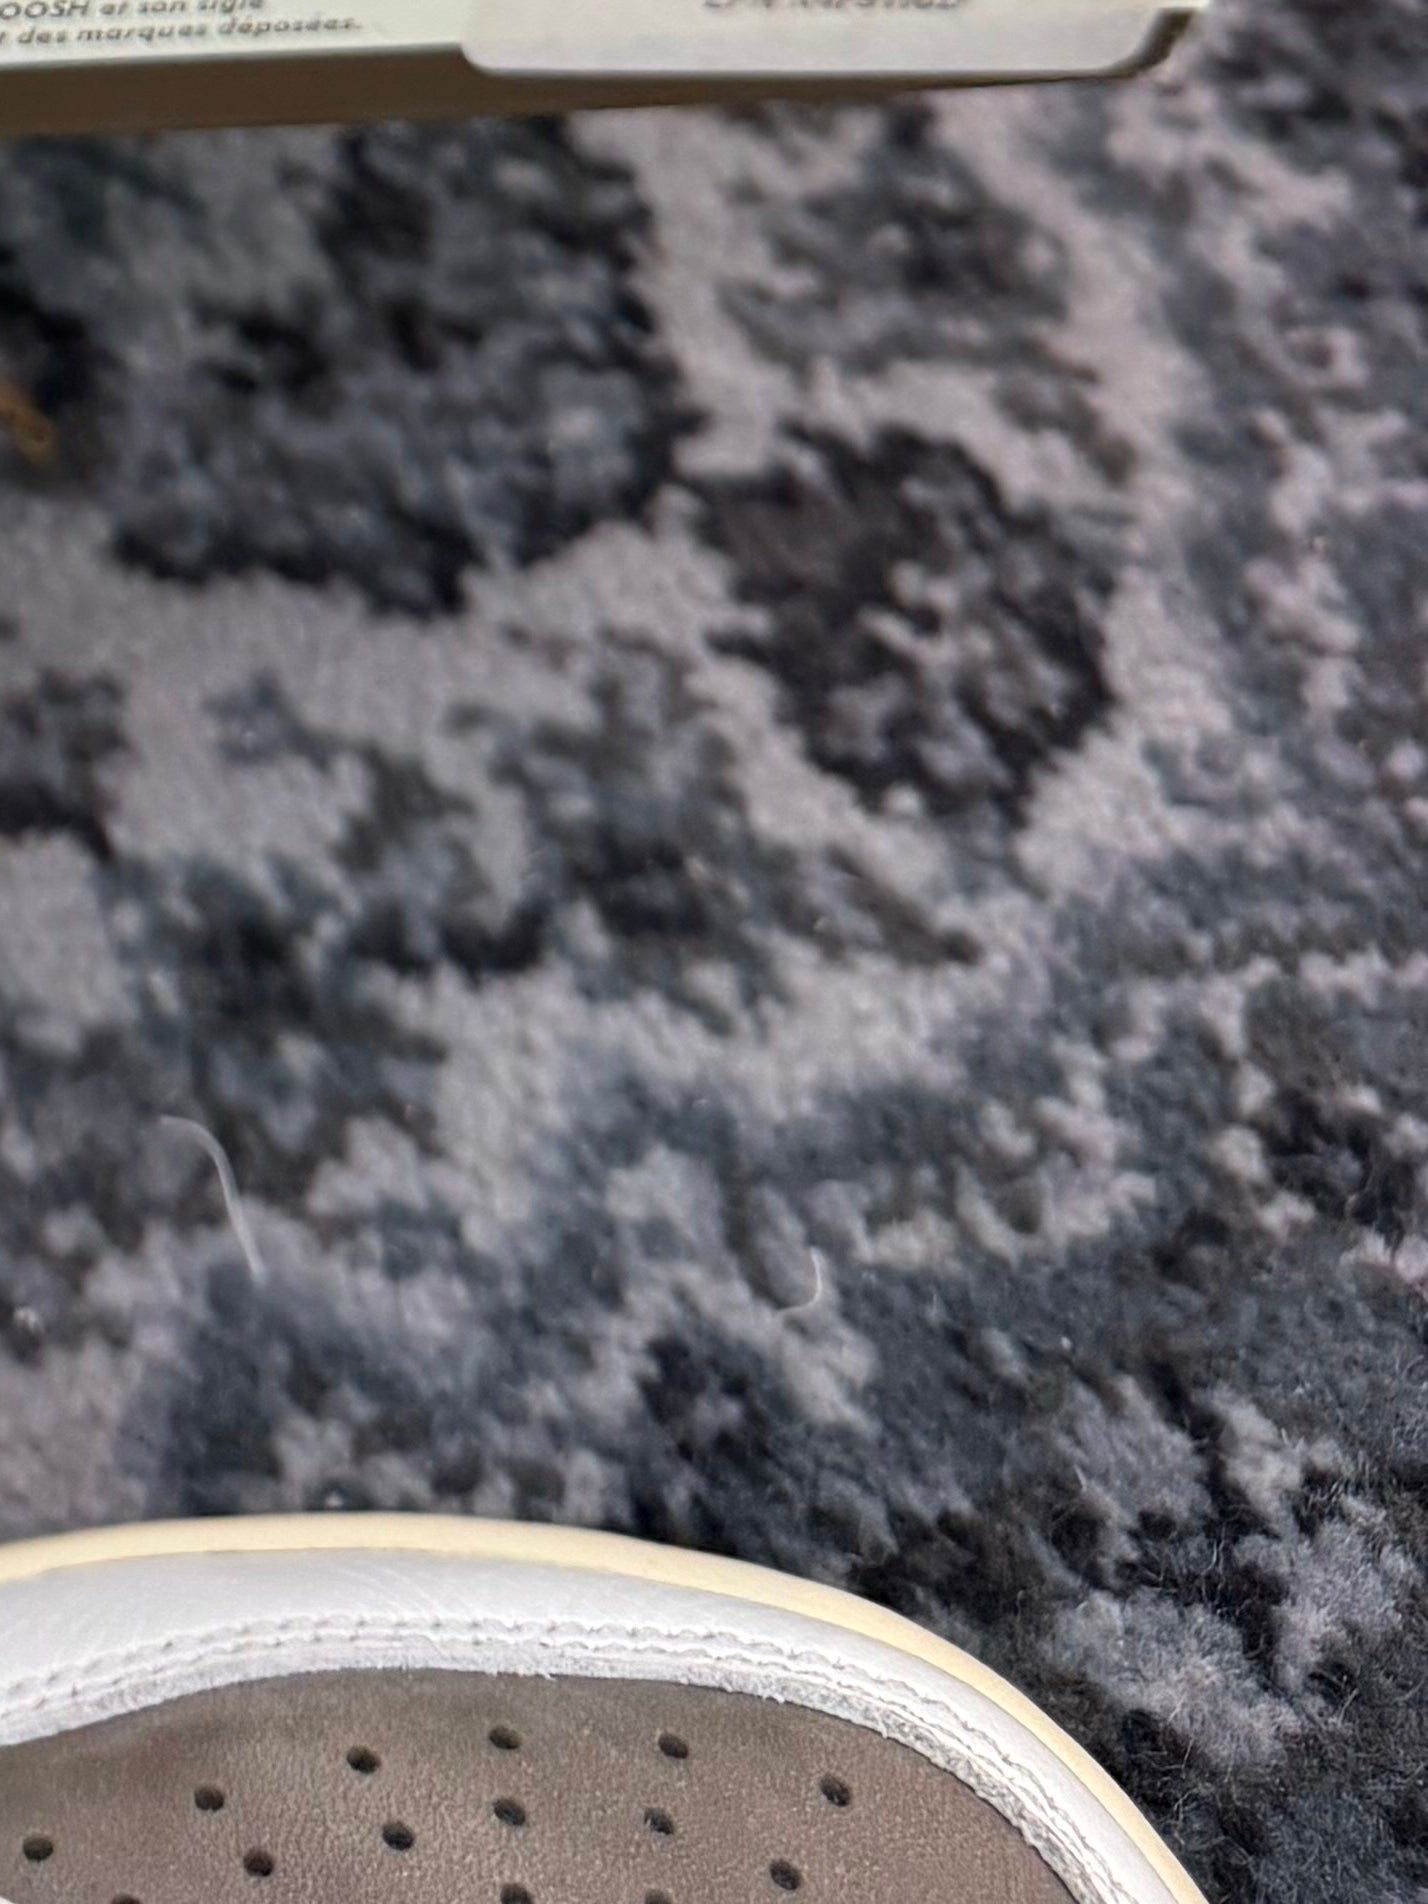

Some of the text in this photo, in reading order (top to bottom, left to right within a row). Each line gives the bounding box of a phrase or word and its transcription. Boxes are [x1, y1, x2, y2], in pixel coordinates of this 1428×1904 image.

[99, 0, 128, 16] et
[18, 28, 68, 44] des
[76, 23, 208, 42] marques
